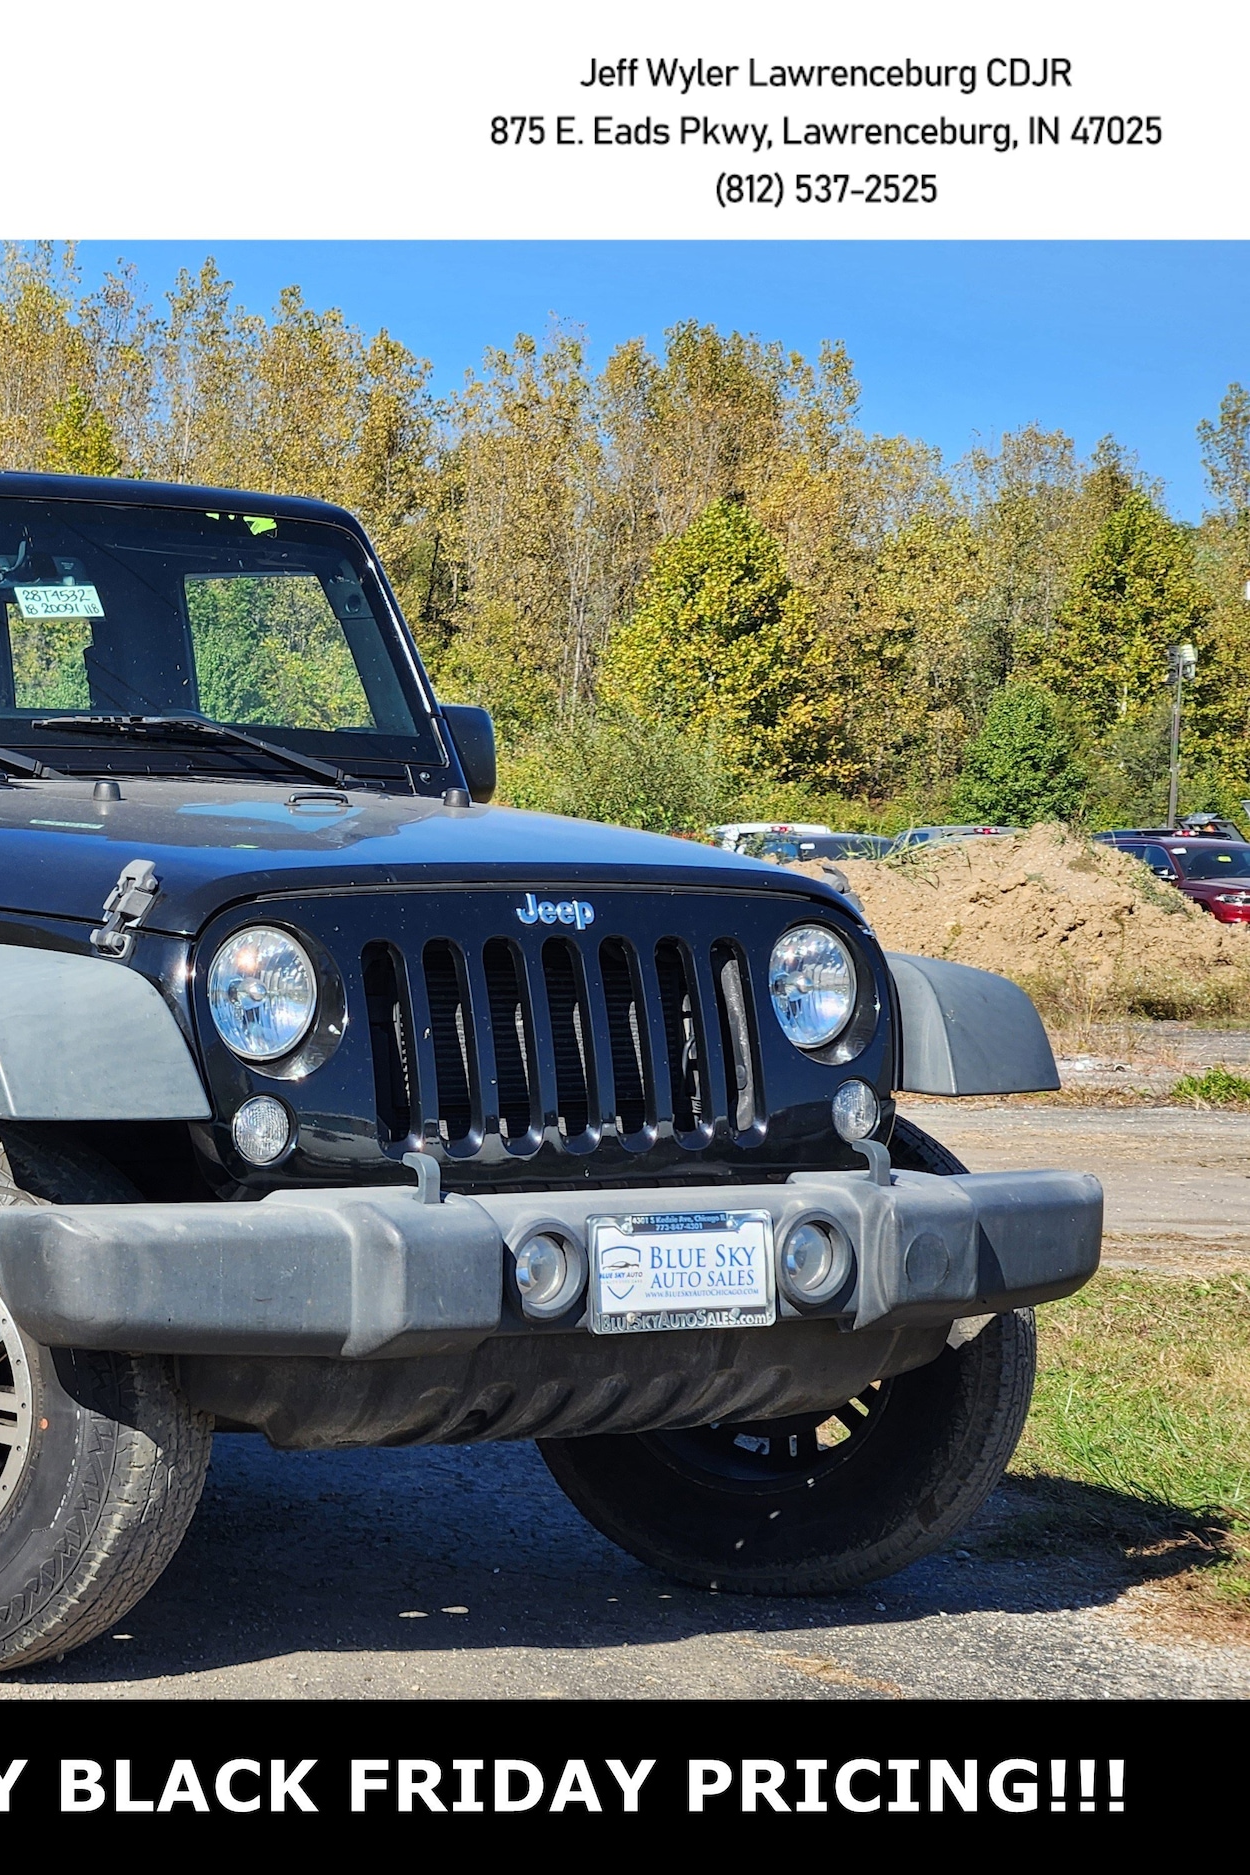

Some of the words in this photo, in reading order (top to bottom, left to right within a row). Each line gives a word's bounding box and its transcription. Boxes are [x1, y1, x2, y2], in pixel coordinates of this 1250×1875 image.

[516, 893, 595, 930] Jeep
[650, 1216, 655, 1224] S
[650, 1246, 706, 1269] BLUE
[715, 1244, 757, 1267] SKY
[650, 1271, 701, 1289] AUTO
[707, 1269, 755, 1287] SALES
